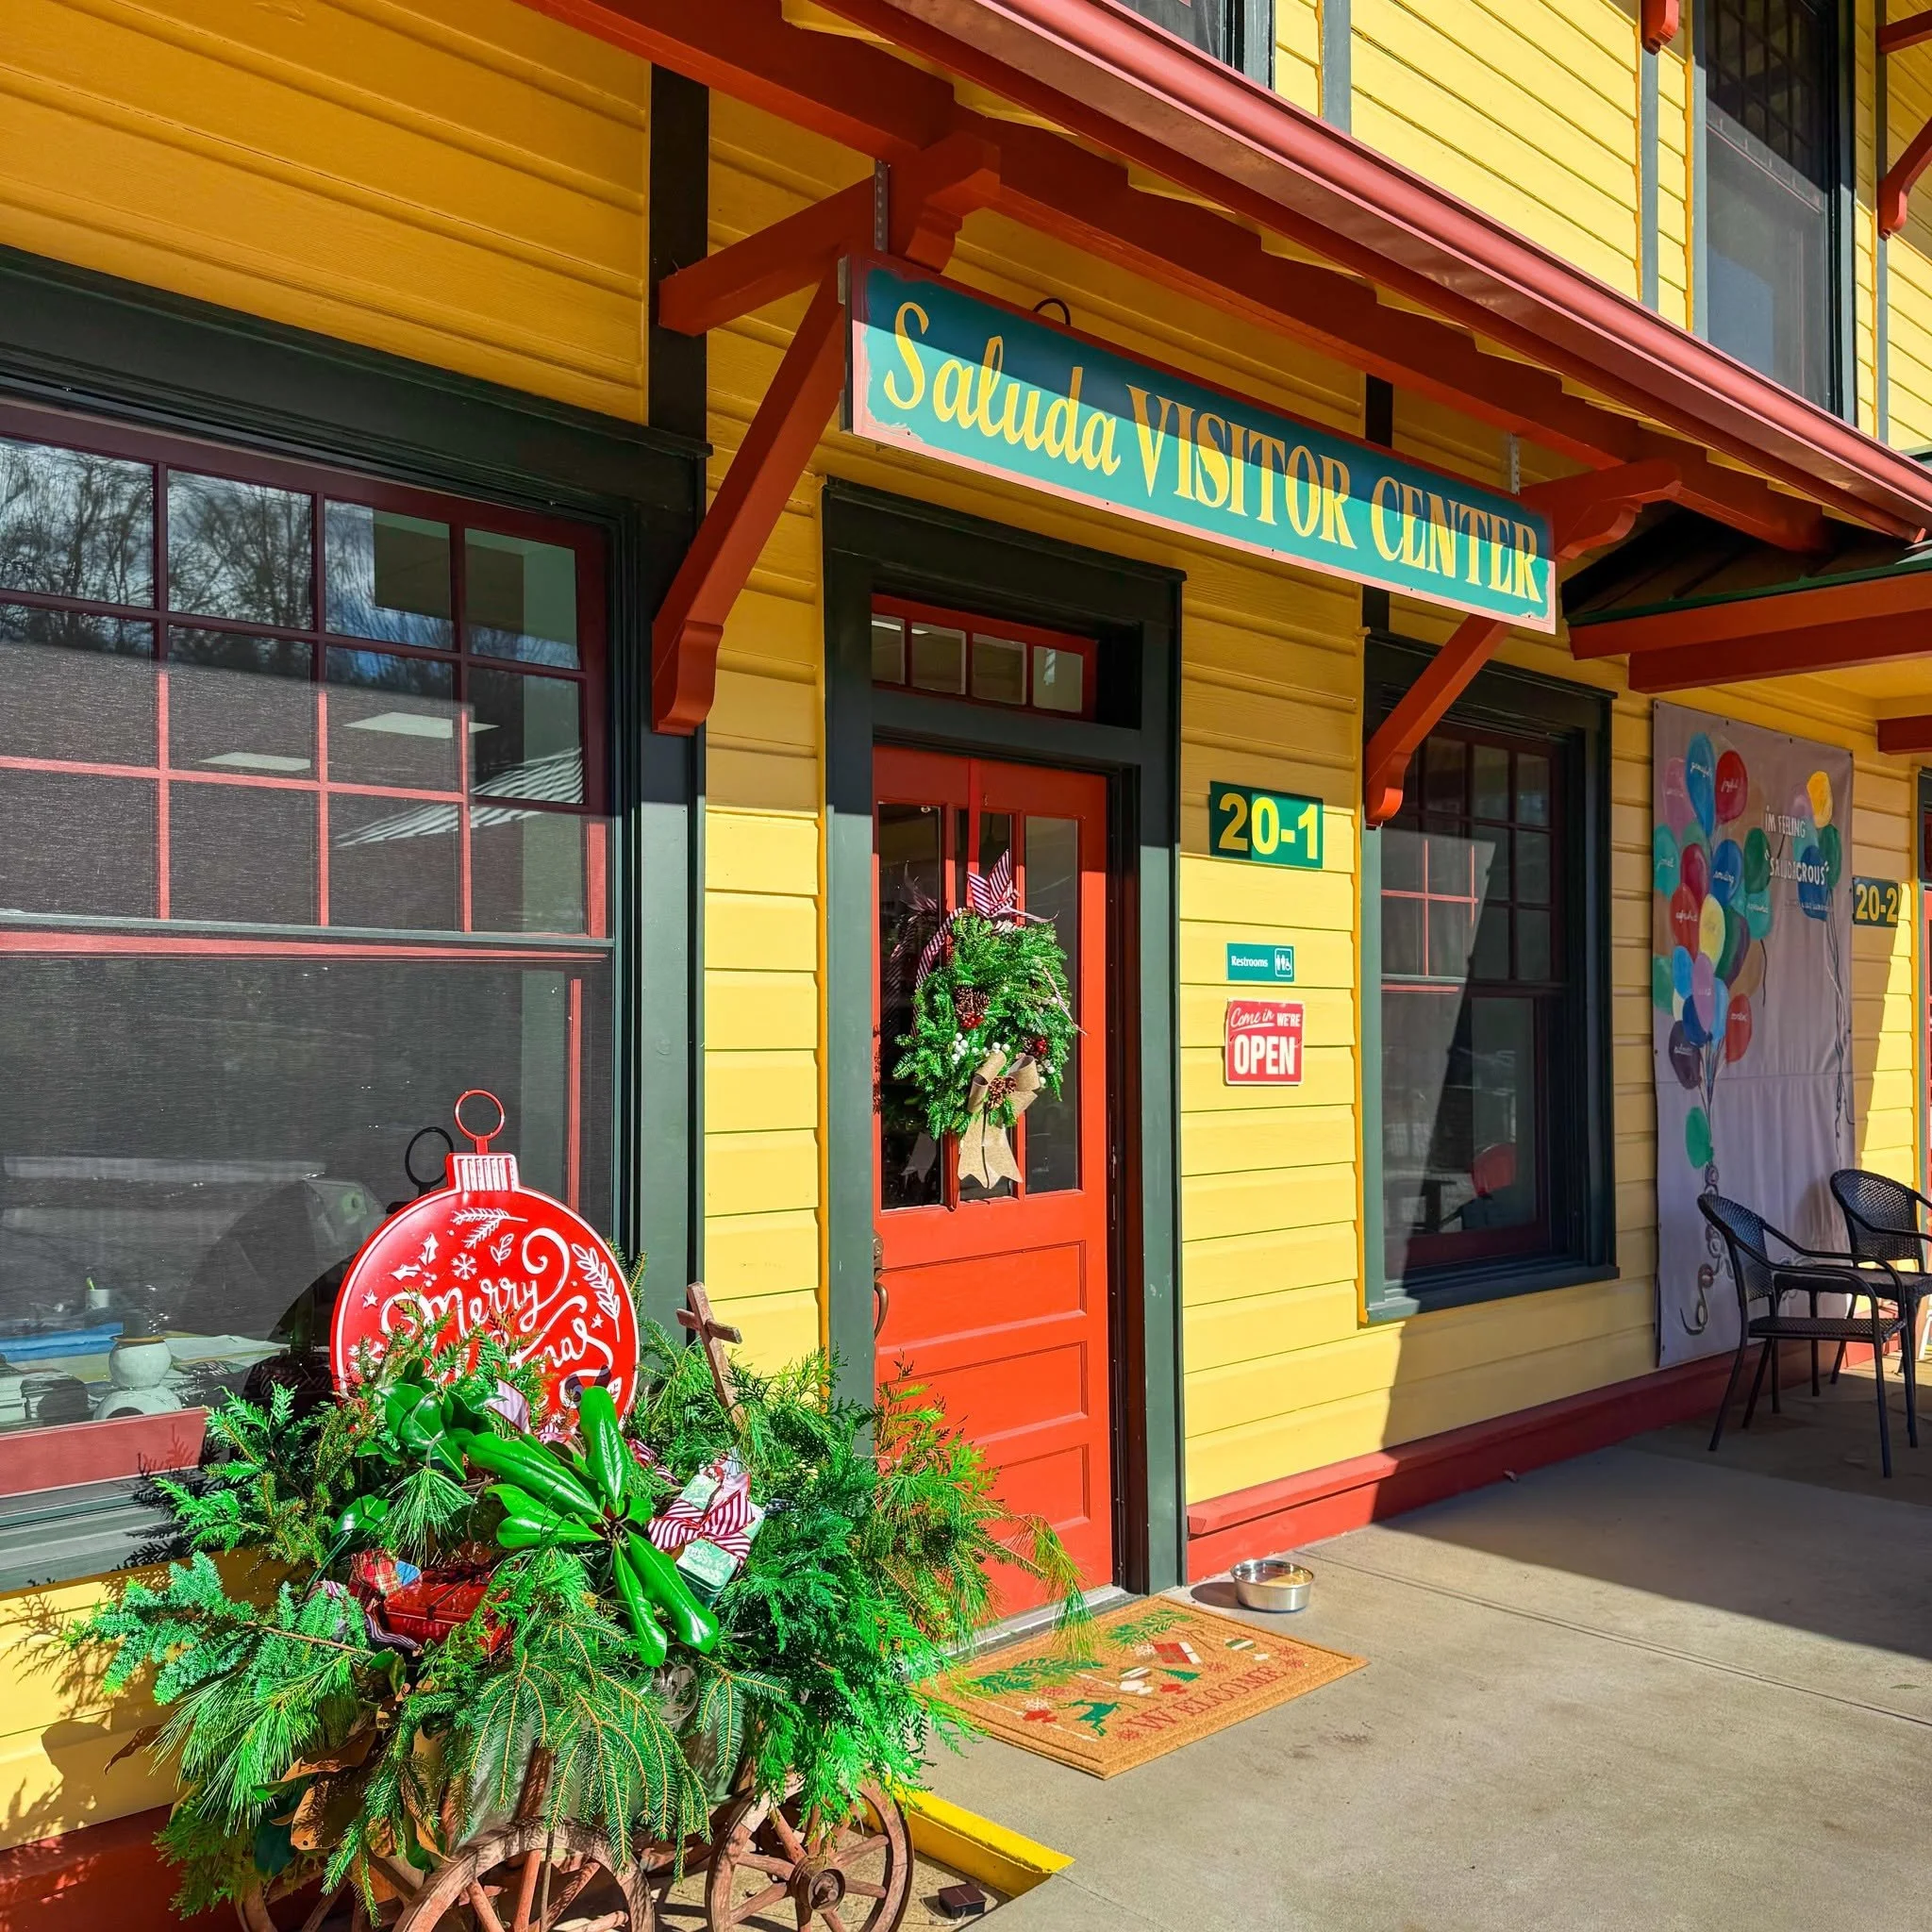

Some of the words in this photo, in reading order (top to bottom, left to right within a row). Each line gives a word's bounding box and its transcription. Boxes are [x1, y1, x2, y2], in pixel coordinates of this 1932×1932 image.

[884, 301, 1121, 475] Saluda
[1125, 384, 1357, 550] VISITOR
[1371, 475, 1544, 604] CENTER
[1218, 792, 1319, 860] 20-1
[1856, 883, 1898, 923] 20-2
[1231, 956, 1268, 968] Restrooms
[1230, 1008, 1260, 1028] Come
[1262, 1008, 1274, 1023] in
[1276, 1012, 1301, 1027] WE'RE
[1234, 1034, 1295, 1075] OPEN
[1119, 1666, 1287, 1731] WELCOME
